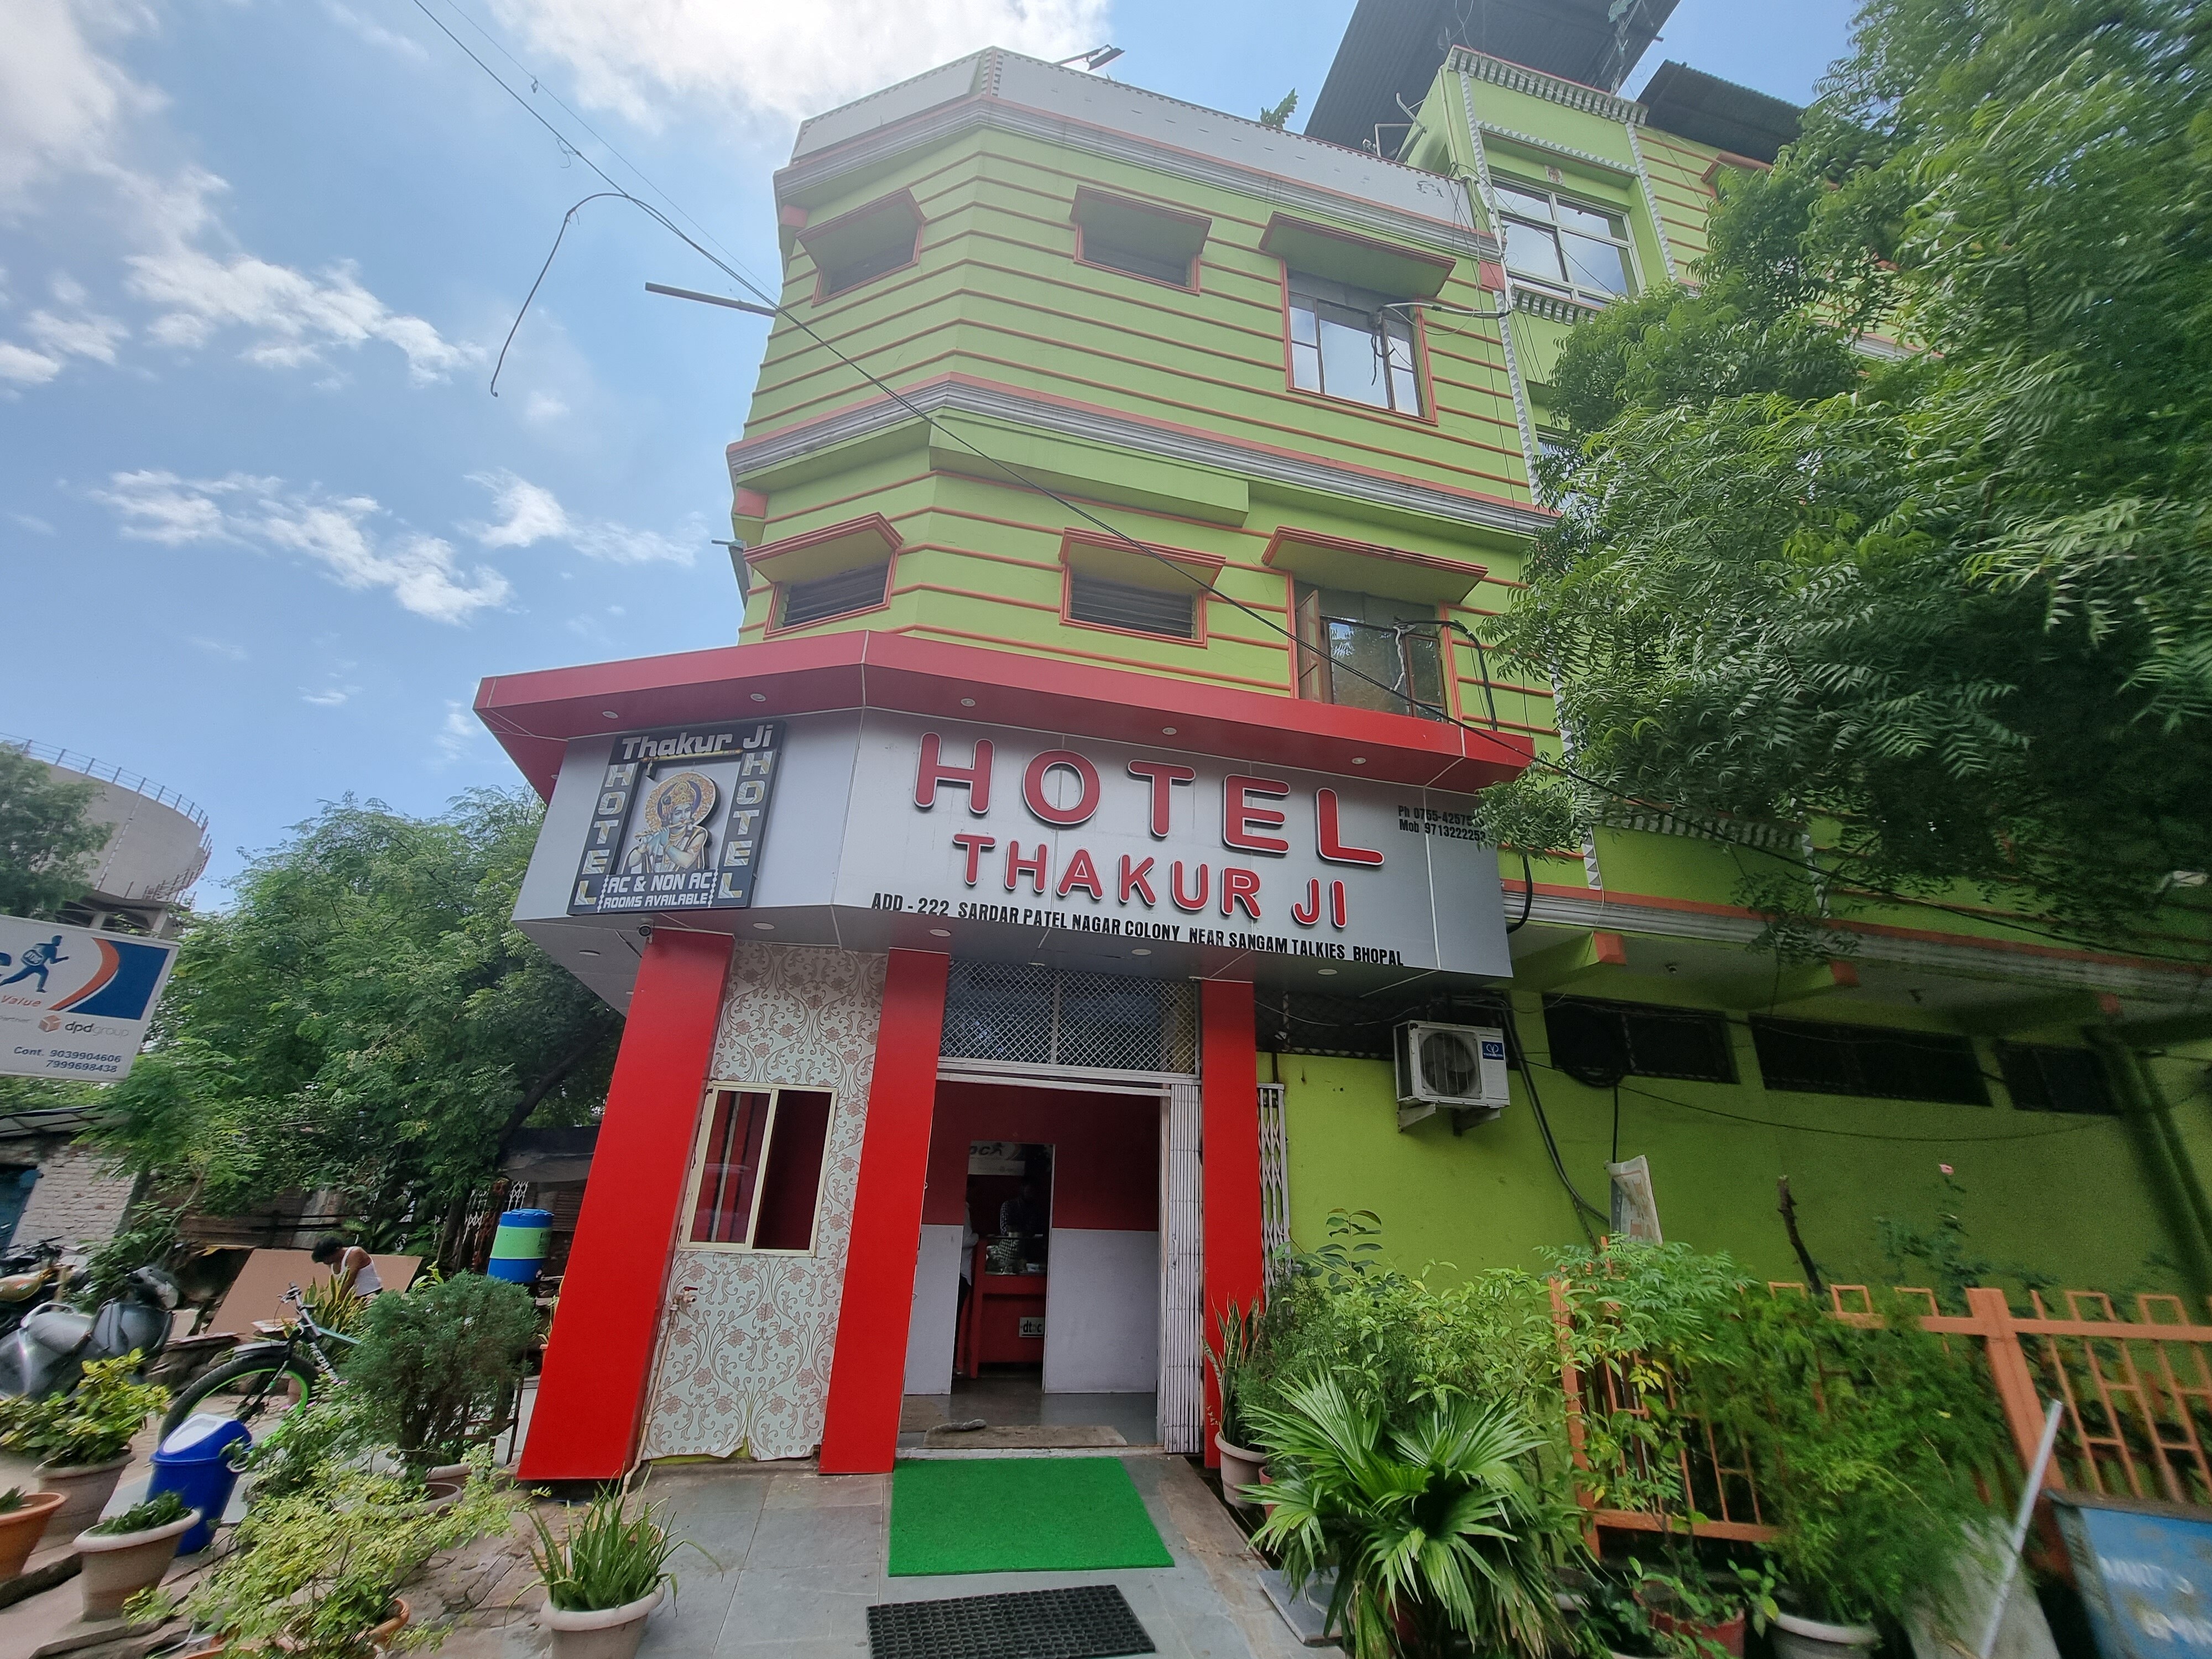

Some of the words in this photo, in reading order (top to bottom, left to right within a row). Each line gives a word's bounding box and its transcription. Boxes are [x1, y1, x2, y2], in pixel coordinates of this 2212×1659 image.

[622, 732, 733, 760] Thakur
[743, 724, 773, 749] Ji
[914, 732, 1385, 866] HOTEL
[1398, 805, 1410, 818] Ph
[574, 763, 639, 905] HOTEL
[718, 750, 773, 899] HOTEL
[1399, 818, 1420, 833] Mob
[607, 877, 631, 894] AC
[633, 875, 647, 893] &
[650, 873, 686, 891] NON
[688, 872, 713, 889] AC
[953, 833, 1261, 919] THAKUR
[1292, 877, 1348, 929] JI
[603, 895, 643, 909] ROOMS
[644, 893, 708, 907] AVAILABLE
[871, 892, 903, 912] ADD
[918, 897, 950, 916] 222
[958, 902, 1019, 925] SARDAR
[1023, 909, 1067, 929] PATEL
[1072, 914, 1121, 936] NAGAR
[1125, 920, 1181, 941] COLONY
[1190, 927, 1224, 947] NEAR
[1229, 932, 1287, 955] SANGAM
[1292, 938, 1345, 959] TALKIES
[1353, 946, 1404, 967] BHOPAL
[1, 995, 41, 1007] Value
[65, 1021, 129, 1037] dpdgroup
[14, 1046, 44, 1056] Cont.
